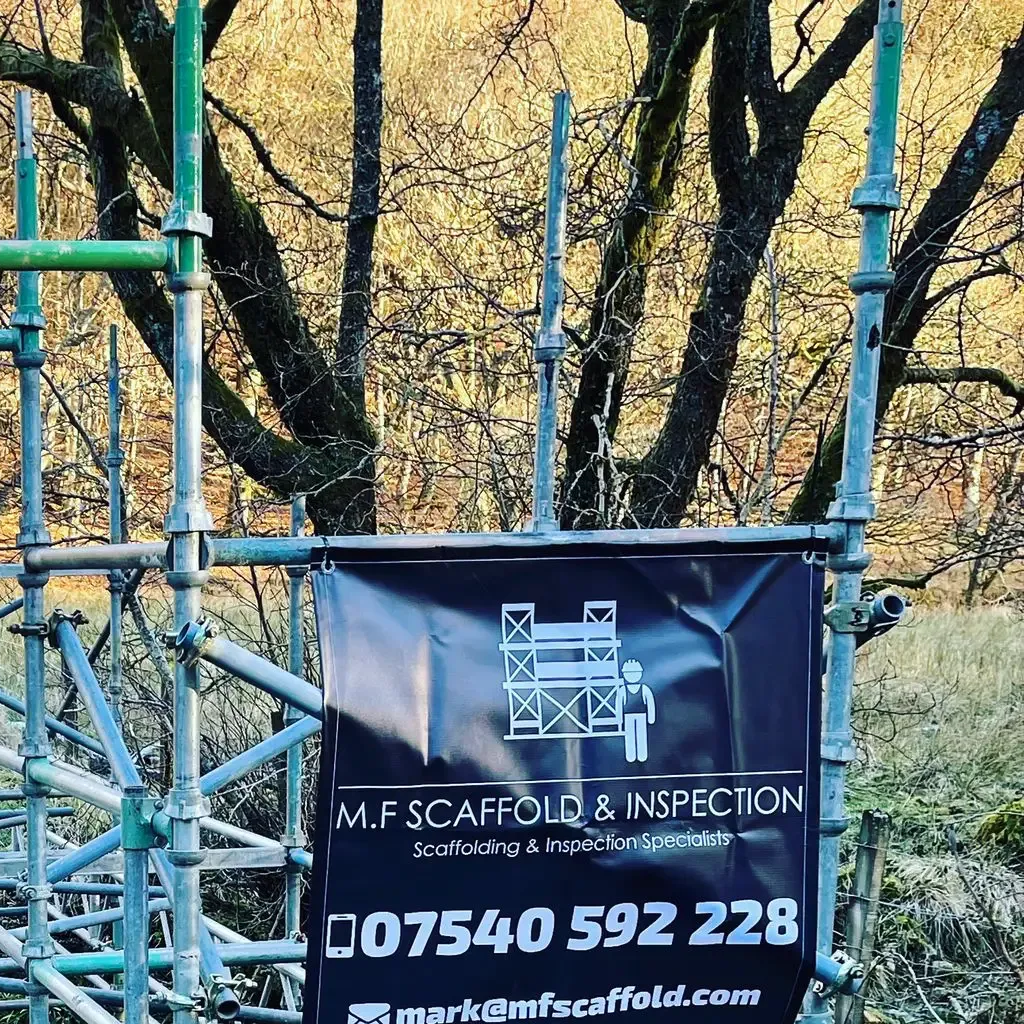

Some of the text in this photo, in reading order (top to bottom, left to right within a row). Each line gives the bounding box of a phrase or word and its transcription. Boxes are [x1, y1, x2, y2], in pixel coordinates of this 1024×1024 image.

[336, 786, 804, 830] M.F SCAFFOLD & INSPECTION
[413, 830, 730, 858] Scaffolding & Inspection Specialists
[360, 898, 799, 958] 07540 592 228
